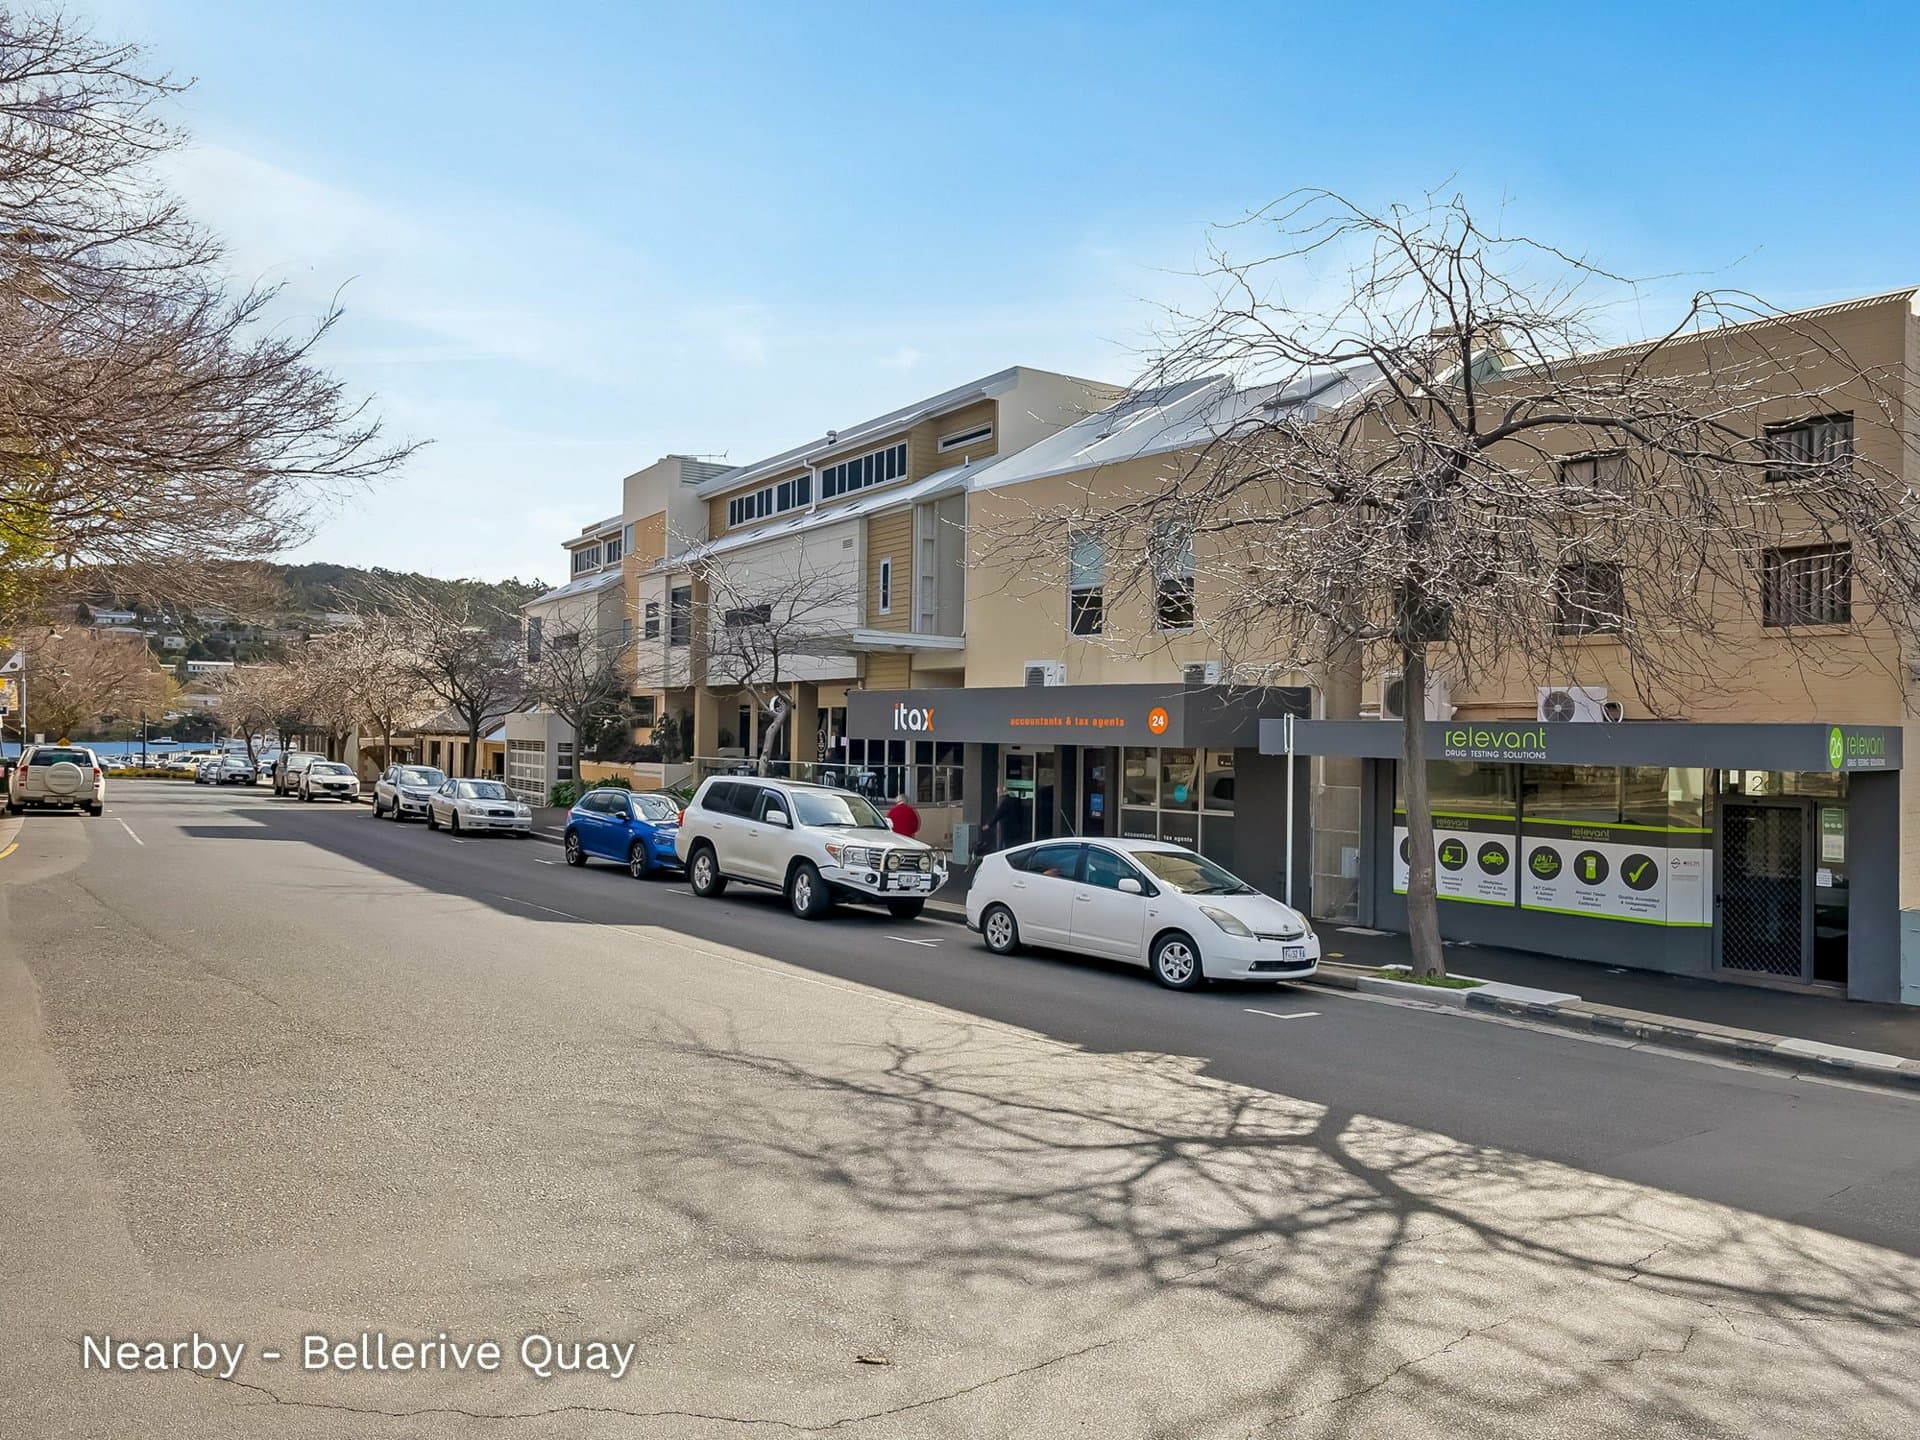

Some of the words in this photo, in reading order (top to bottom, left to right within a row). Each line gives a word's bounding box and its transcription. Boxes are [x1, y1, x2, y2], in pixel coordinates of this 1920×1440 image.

[893, 703, 935, 731] itax
[1010, 716, 1062, 727] accountants
[1065, 716, 1072, 727] &
[1075, 717, 1089, 727] tax
[1093, 717, 1125, 729] agents
[1152, 715, 1164, 727] 24
[1444, 726, 1546, 749] relevant
[1831, 736, 1841, 759] 26
[1847, 732, 1885, 756] relevant
[1445, 749, 1467, 757] DRUG
[1471, 750, 1499, 758] TESTING
[1503, 751, 1546, 759] SOLUTIONS
